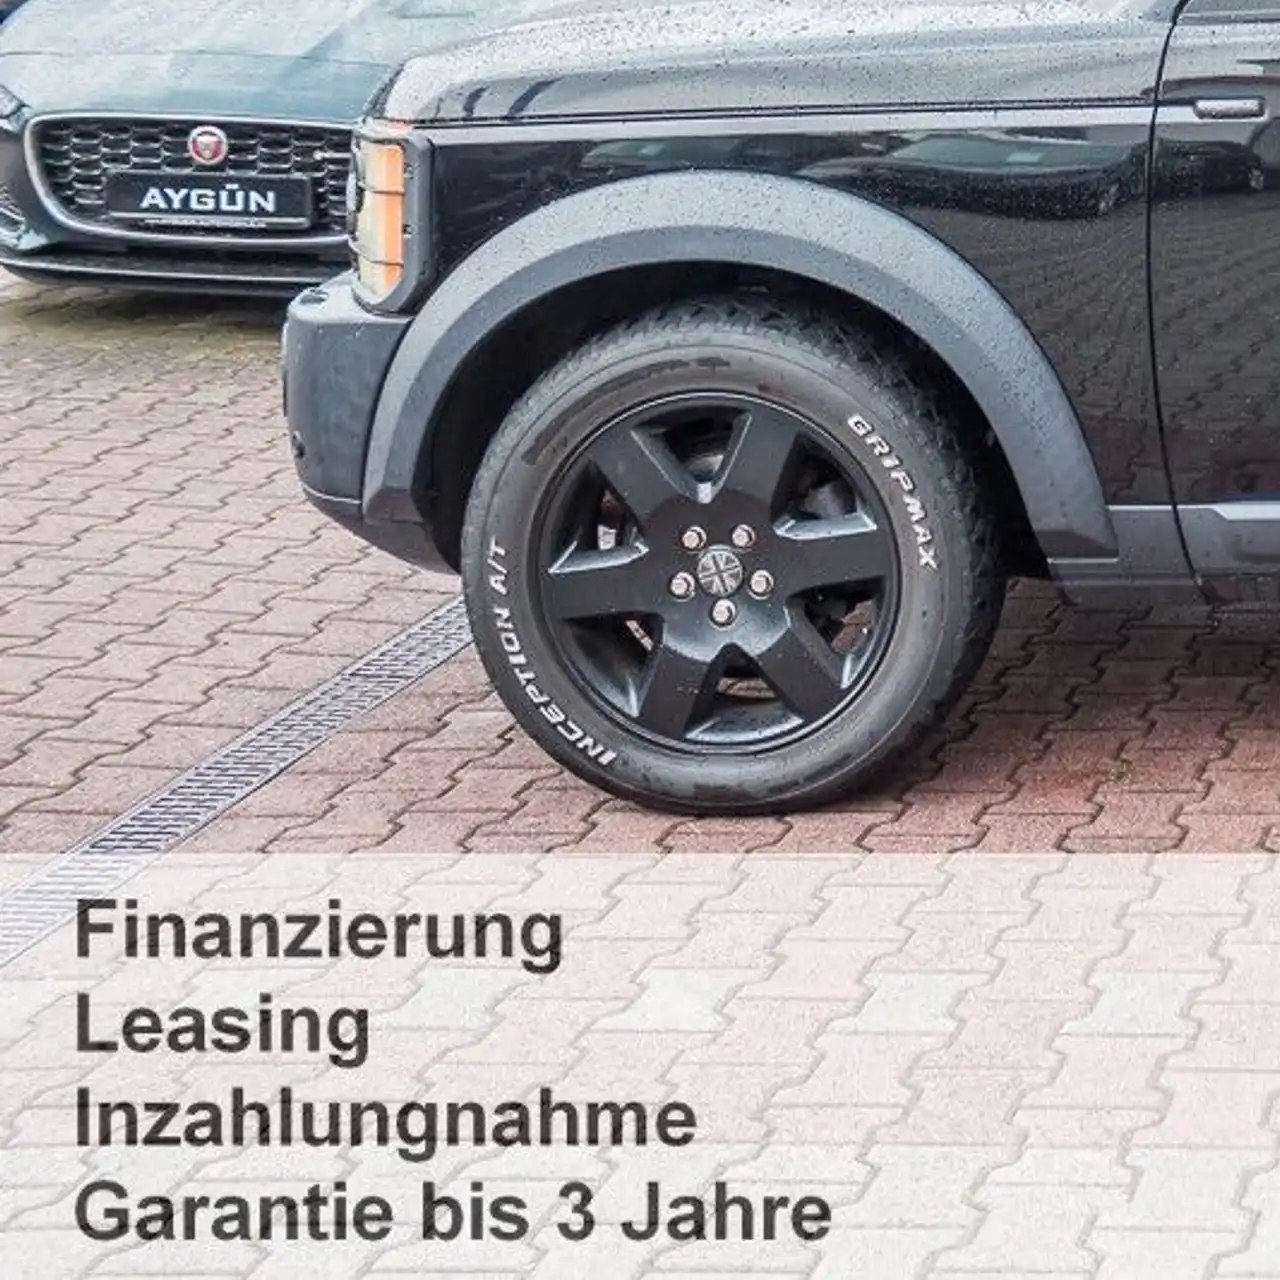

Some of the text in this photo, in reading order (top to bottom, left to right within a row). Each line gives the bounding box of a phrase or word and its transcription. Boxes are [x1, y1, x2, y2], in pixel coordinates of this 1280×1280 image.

[139, 183, 276, 213] AYGÜN
[847, 415, 938, 569] GRIPMAX
[487, 536, 617, 766] INCEPTION A/T
